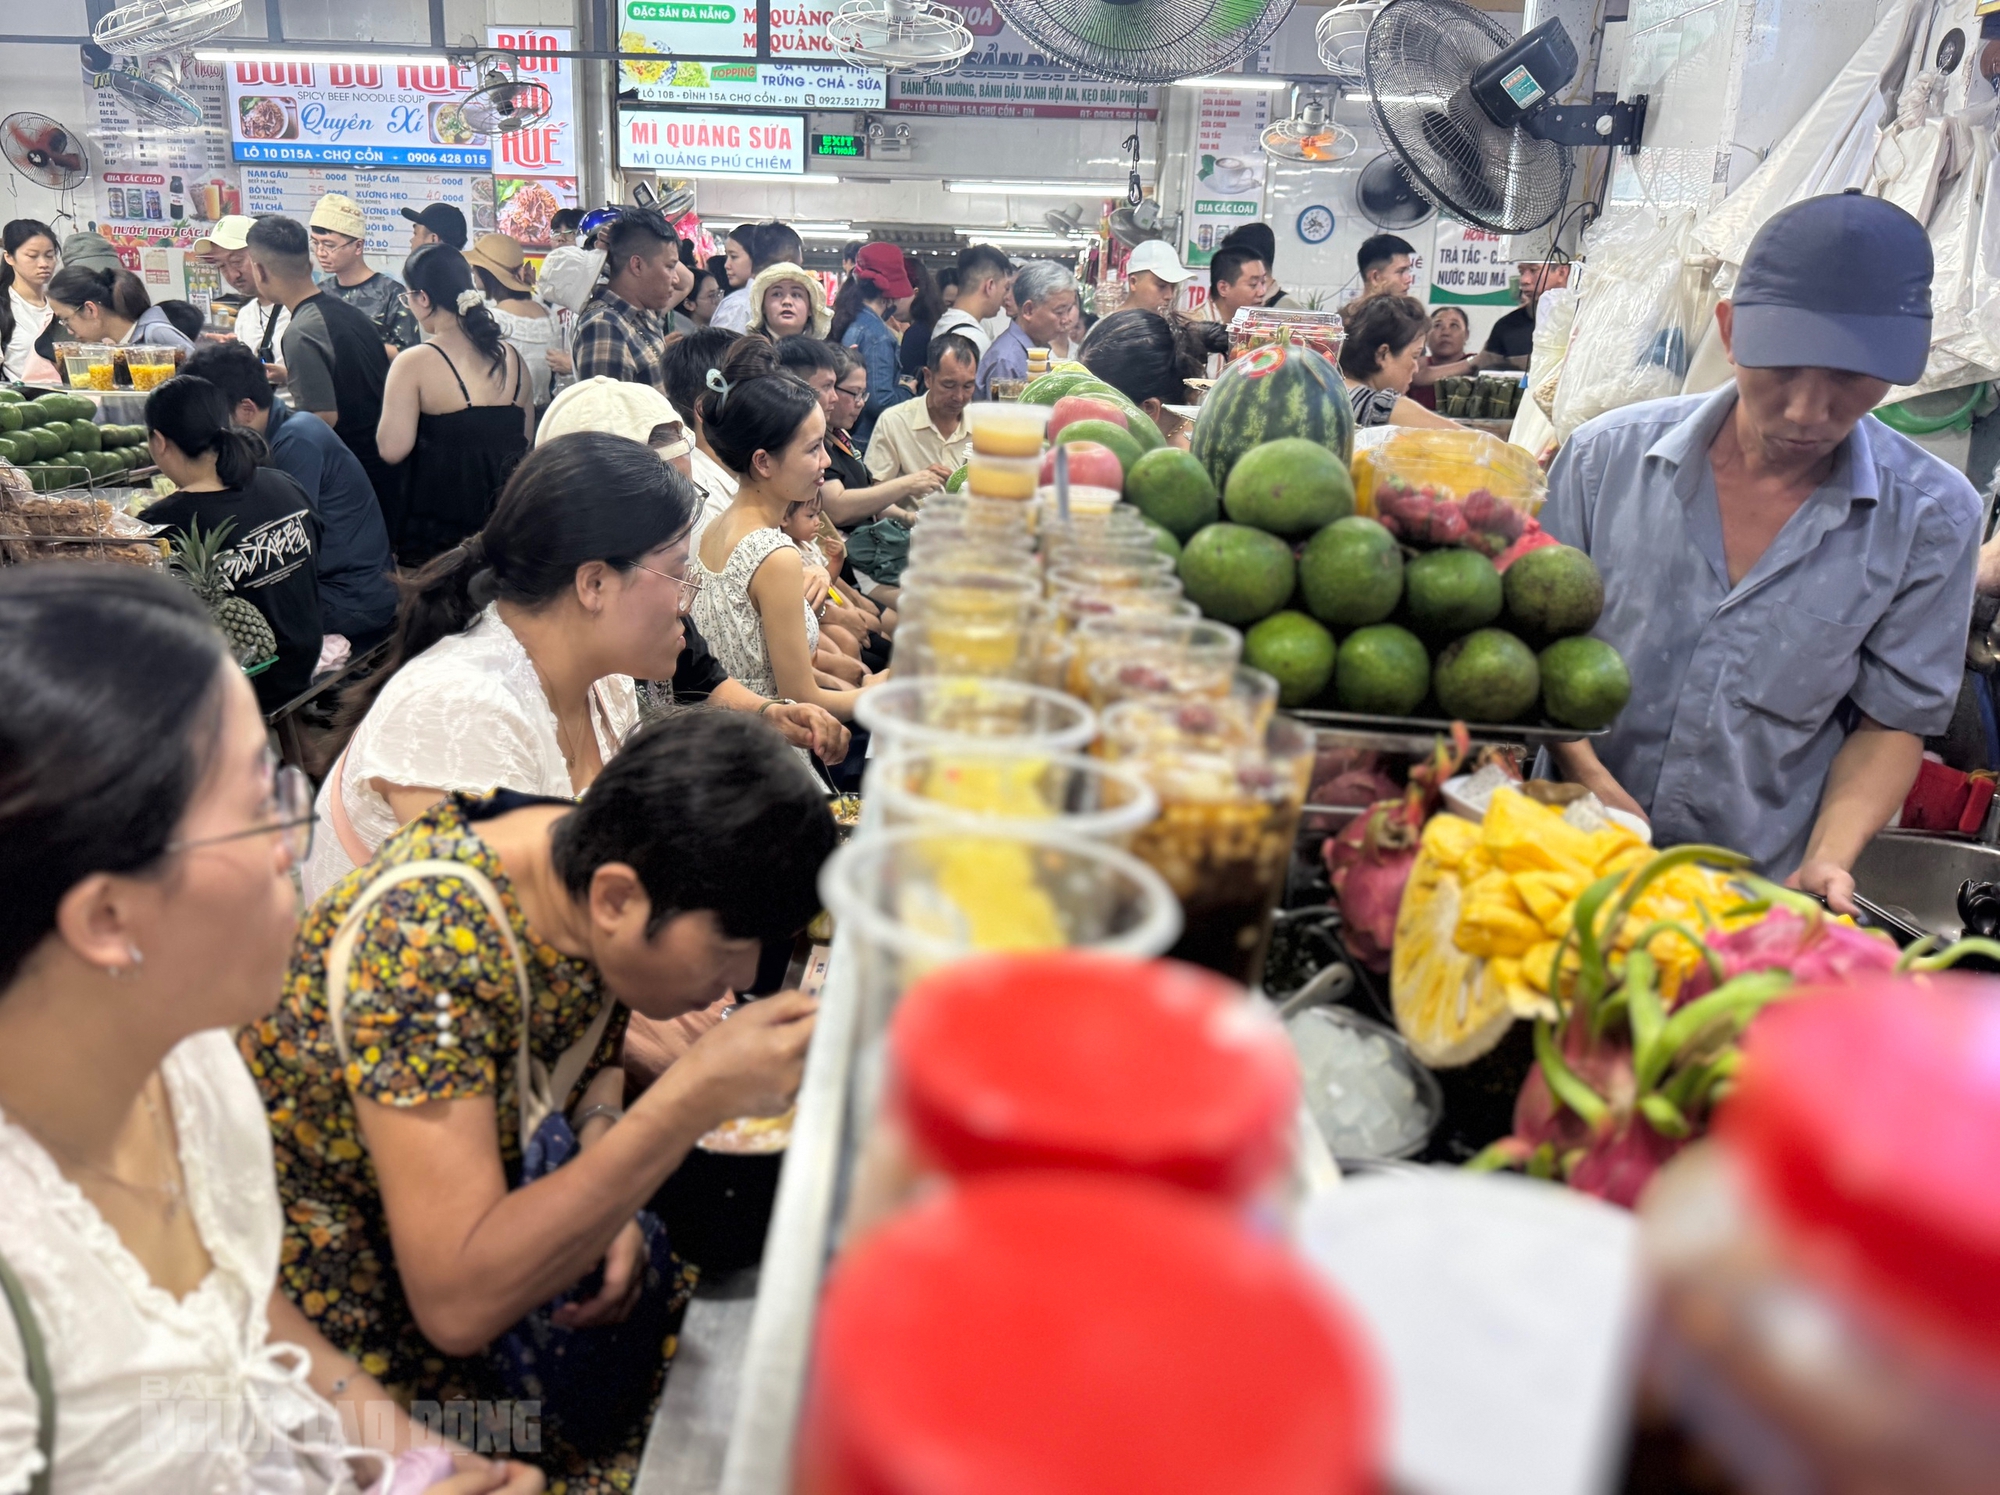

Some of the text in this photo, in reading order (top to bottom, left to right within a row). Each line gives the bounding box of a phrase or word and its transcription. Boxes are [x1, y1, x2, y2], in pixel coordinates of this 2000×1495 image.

[633, 5, 730, 20] ĐẶC SẢN ĐÀ NẴNG
[743, 8, 757, 24] M
[770, 3, 834, 28] QUẢNG
[743, 33, 757, 49] M
[770, 28, 833, 53] QUẢNG
[713, 66, 756, 78] TOPPING
[762, 73, 882, 91] TRỨNG CHẢ SỨA
[297, 91, 425, 104] SPICY BEEF NOODLE SOUP
[642, 88, 655, 98] LÔ
[658, 90, 674, 99] 10B
[682, 89, 706, 100] ĐÌNH
[709, 92, 727, 101] 15A
[729, 93, 752, 104] CHỢ
[784, 95, 798, 104] ĐN
[819, 96, 880, 107] 0927.521.777
[900, 79, 923, 95] BÁNH
[945, 80, 977, 98] NƯỚNG,
[979, 80, 1002, 98] BÁNH
[1023, 86, 1047, 100] XANH
[1048, 84, 1063, 104] HỘI
[1065, 87, 1079, 103] AN,
[1081, 88, 1098, 104] KẸO
[1120, 89, 1148, 107] PHỤNG
[962, 105, 978, 115] 15A
[301, 102, 424, 142] Quyên Xí
[631, 118, 792, 150] MÌ QUẢNG SỨA
[502, 122, 566, 169] HUẾ
[822, 135, 854, 147] EXIT
[243, 145, 259, 158] LÔ
[263, 148, 278, 158] 10
[281, 148, 313, 159] D15A
[323, 149, 352, 163] CHỢ
[407, 152, 437, 163] 0906
[439, 153, 461, 164] 428
[464, 154, 487, 164] 015
[633, 150, 792, 170] MÌ QUẢNG PHÚ CHIÊM
[106, 174, 162, 185] BIA CÁC LOẠI
[441, 178, 463, 186] 000đ
[248, 185, 262, 194] BÒ
[262, 185, 283, 195] VIÊN
[355, 190, 389, 199] XƯƠNG
[389, 192, 408, 200] HEO
[442, 194, 464, 202] 000đ
[250, 202, 264, 211] TÁI
[362, 207, 389, 215] ƯƠNG
[1197, 203, 1254, 215] BIA CÁC LOẠI
[112, 225, 143, 236] NƯỚC
[147, 227, 176, 238] NGỌT
[180, 227, 202, 238] CÁC
[365, 223, 395, 232] UÔI BÒ
[364, 239, 389, 248] IÒ BÒ
[1440, 246, 1458, 263] TRÀ
[1461, 243, 1481, 264] TẮC
[1437, 269, 1466, 286] NƯỚC
[1467, 271, 1488, 286] RAU
[1489, 269, 1506, 287] MÁ
